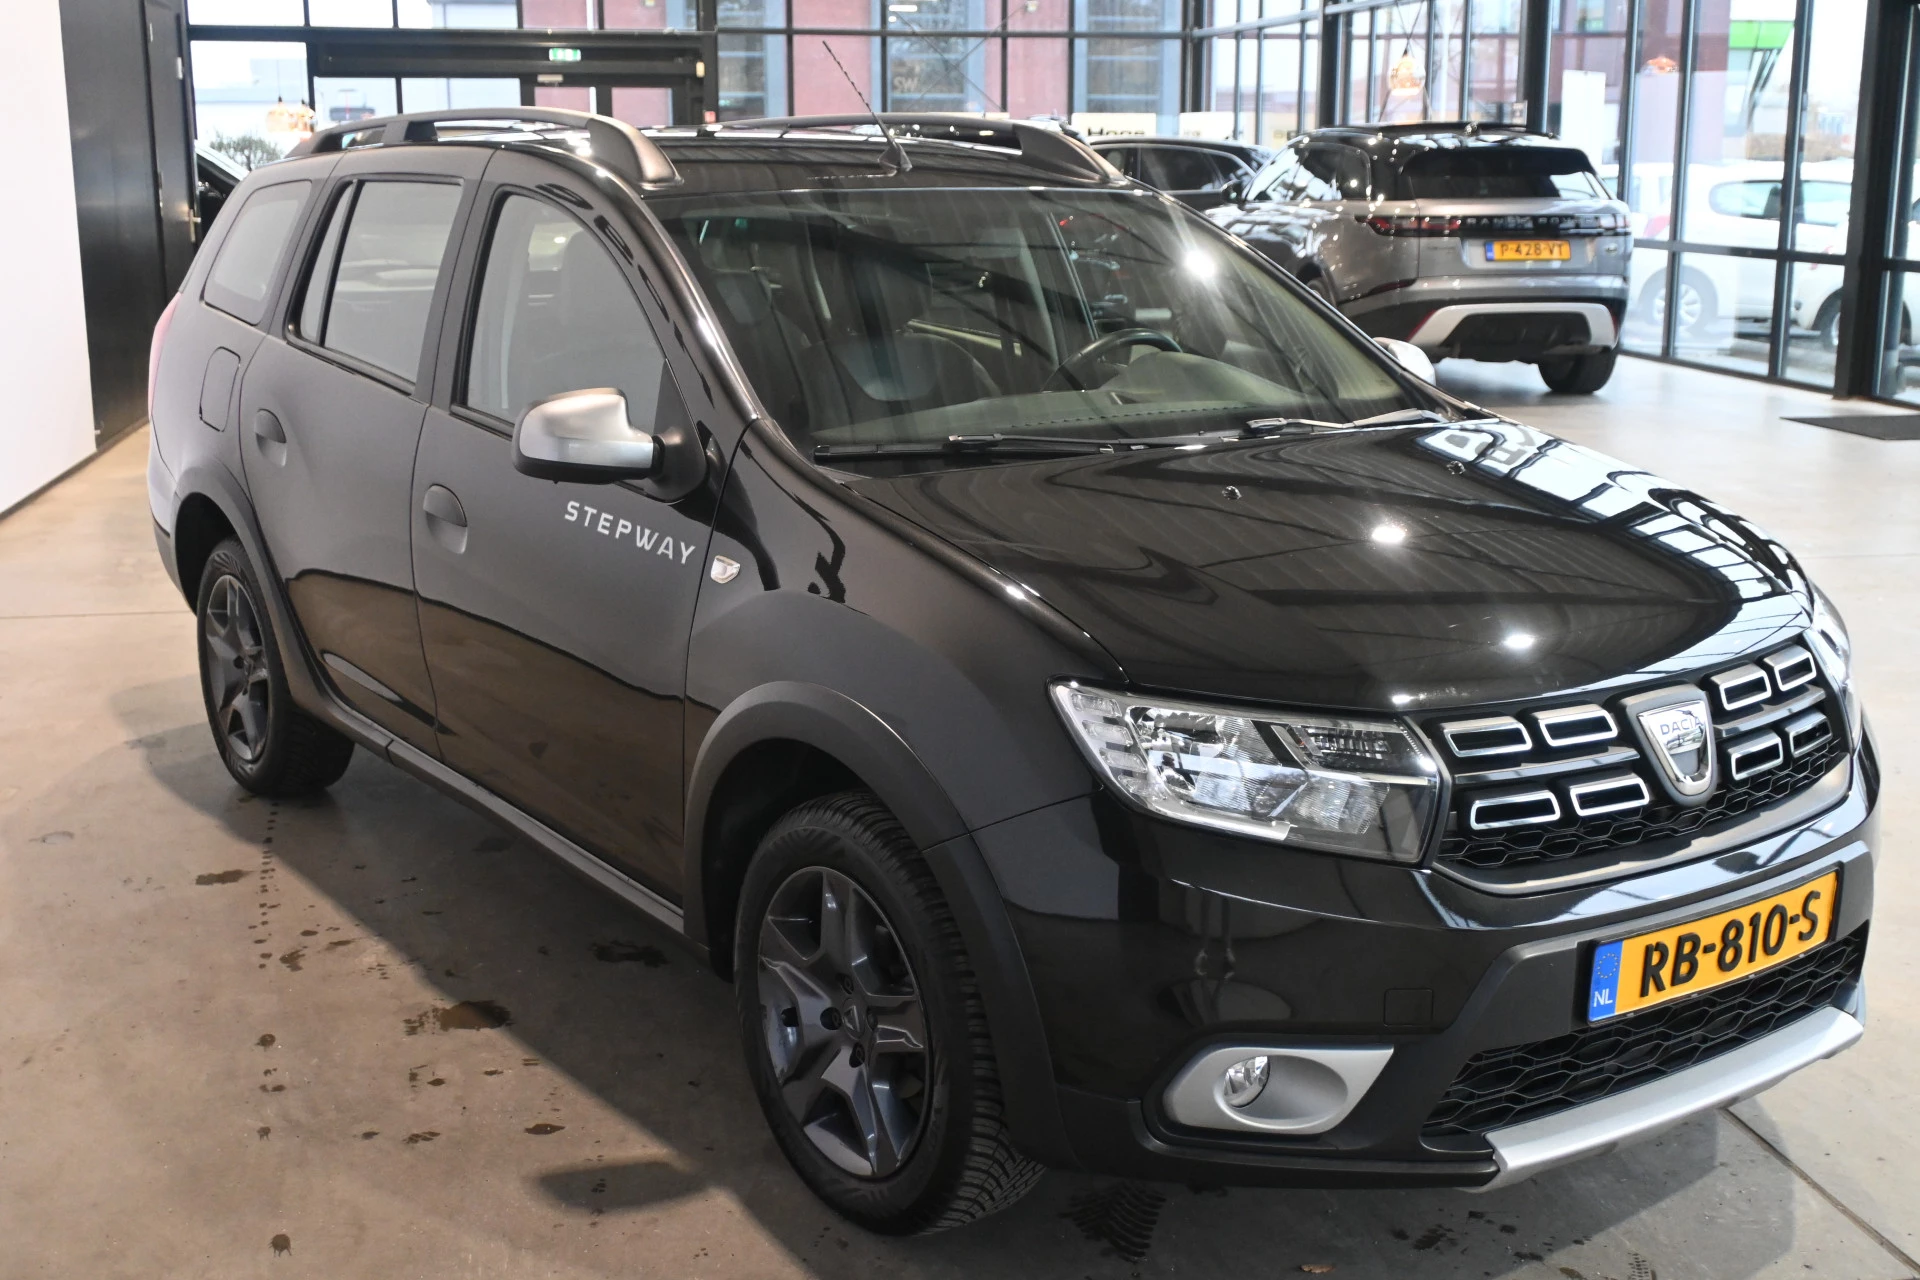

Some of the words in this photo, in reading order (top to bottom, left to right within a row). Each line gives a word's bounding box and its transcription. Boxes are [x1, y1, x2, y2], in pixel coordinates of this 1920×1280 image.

[1500, 242, 1564, 257] P-428-VT
[564, 500, 696, 565] STEPWAY
[1660, 716, 1704, 736] DACIA
[1640, 890, 1821, 998] RB-810-S
[1593, 989, 1613, 1008] NL
